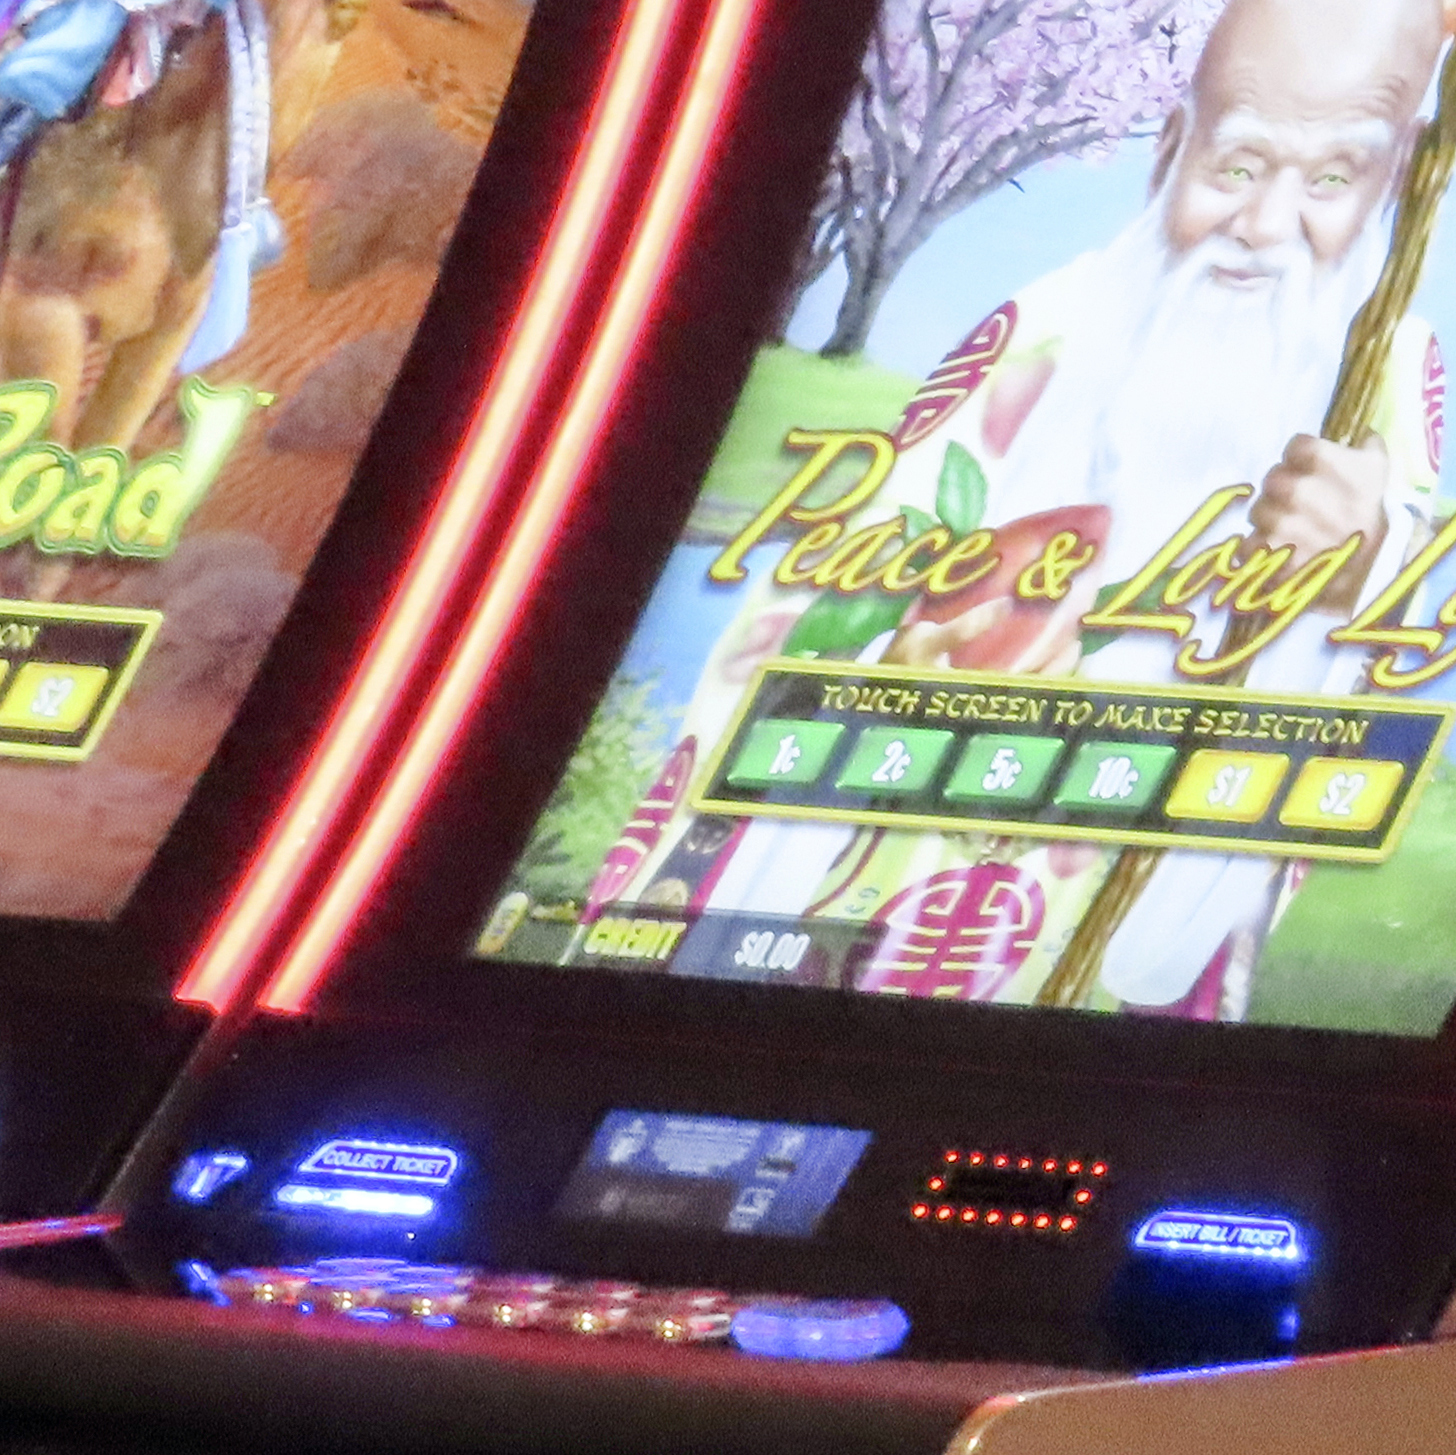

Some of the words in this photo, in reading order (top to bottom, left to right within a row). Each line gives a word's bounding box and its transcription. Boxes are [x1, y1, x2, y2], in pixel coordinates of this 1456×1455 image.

[708, 427, 1003, 596] Peace
[1016, 529, 1095, 601] &
[1080, 482, 1365, 676] Long
[821, 683, 922, 716] TOUCH
[924, 690, 1048, 723] SCREEN
[1054, 698, 1094, 728] TO
[1093, 702, 1192, 734] MAKE
[1193, 708, 1371, 746] SELECTION
[1207, 764, 1254, 807] $1
[1318, 772, 1366, 816] $2
[733, 929, 813, 972] $0.00
[320, 1148, 392, 1171] COLLECT
[391, 1153, 449, 1177] TICKET
[1149, 1221, 1201, 1241] INSERT
[1198, 1223, 1228, 1242] BILL
[1237, 1226, 1290, 1246] TICKET
